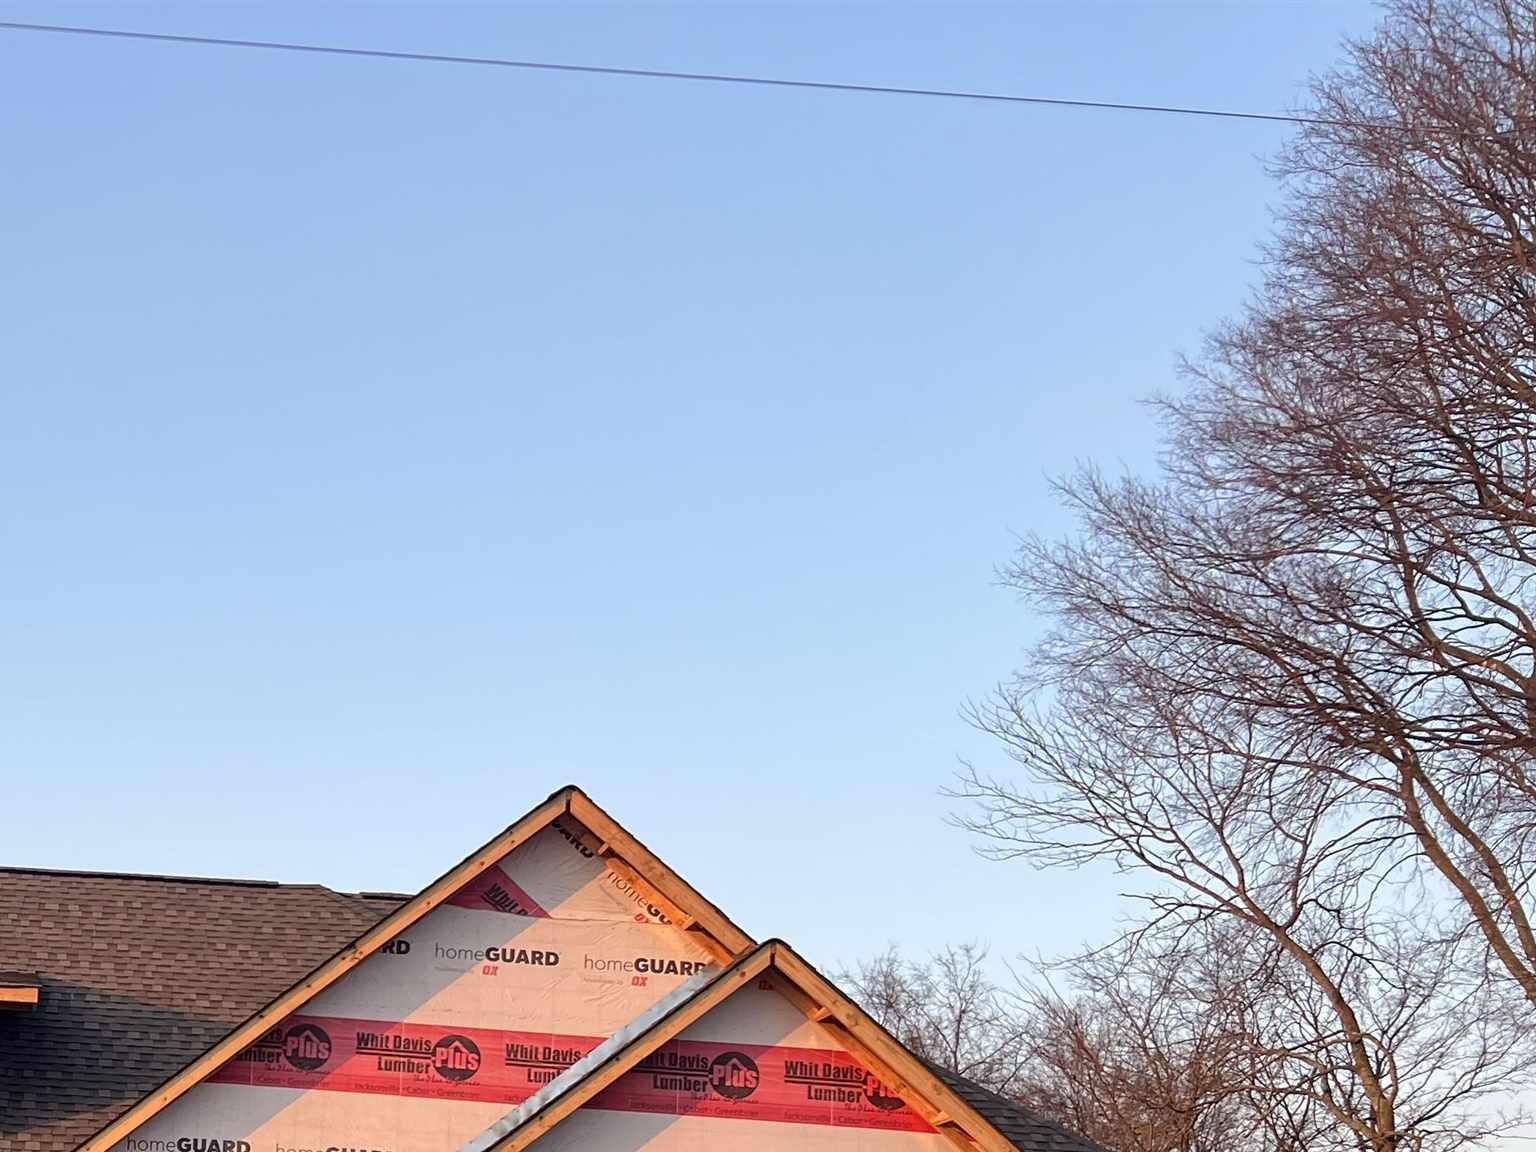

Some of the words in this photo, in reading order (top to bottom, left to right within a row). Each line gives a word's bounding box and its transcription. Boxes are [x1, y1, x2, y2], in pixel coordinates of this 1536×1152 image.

[434, 943, 560, 966] homeGUARD
[356, 1031, 390, 1049] Whit
[393, 1034, 432, 1052] Davis
[435, 1041, 480, 1071] Plus
[505, 1043, 540, 1060] Whit
[542, 1045, 581, 1062] Davis
[669, 1052, 709, 1069] Davis
[377, 1055, 431, 1074] Lumber
[712, 1058, 758, 1089] Plus
[784, 1060, 818, 1078] Whit
[822, 1062, 863, 1081] Davis
[652, 1074, 708, 1093] Lumber
[807, 1085, 862, 1104] Lumber
